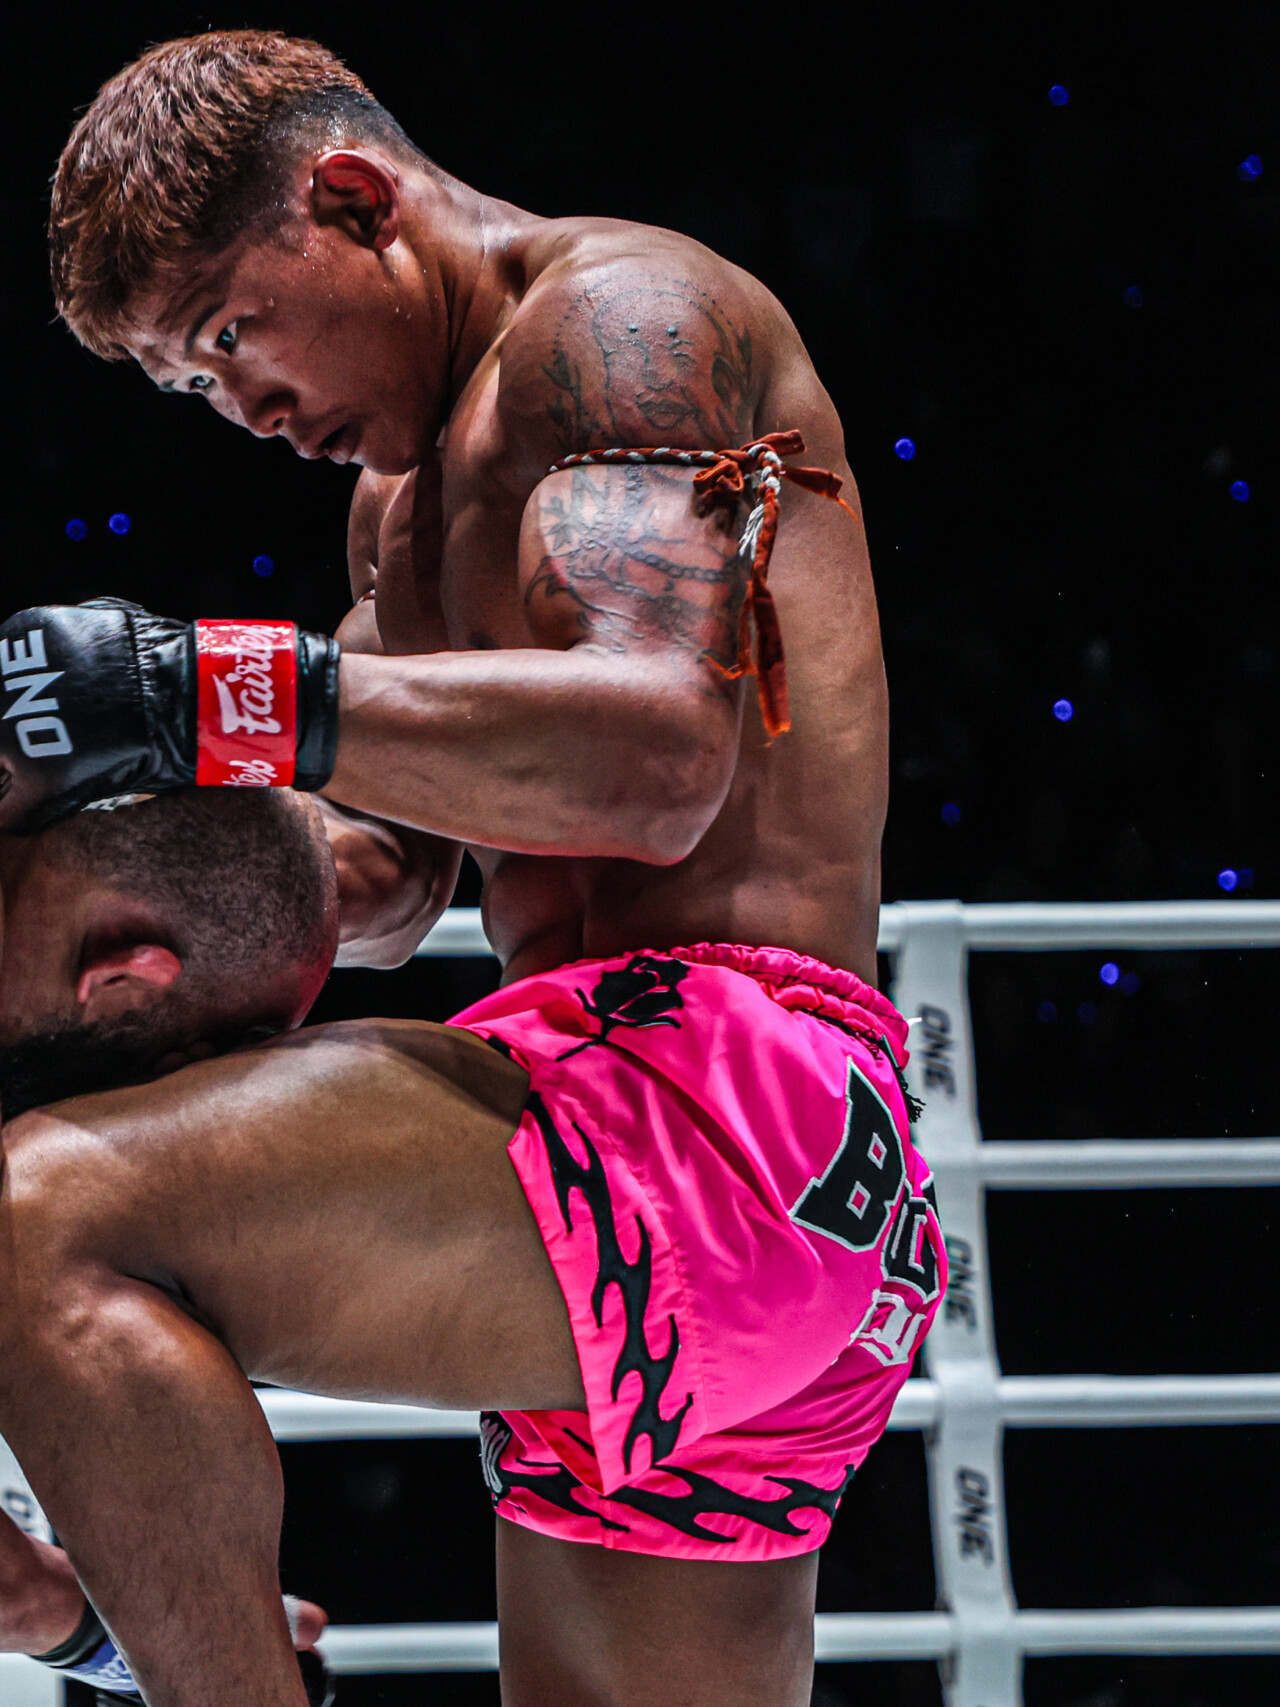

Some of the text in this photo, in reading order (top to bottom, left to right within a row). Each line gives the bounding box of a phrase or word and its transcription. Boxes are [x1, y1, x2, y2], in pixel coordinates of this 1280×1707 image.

[213, 624, 281, 735] Fairtex
[917, 1002, 957, 1100] ONE
[944, 1232, 978, 1335] ONE
[953, 1465, 995, 1567] ONE
